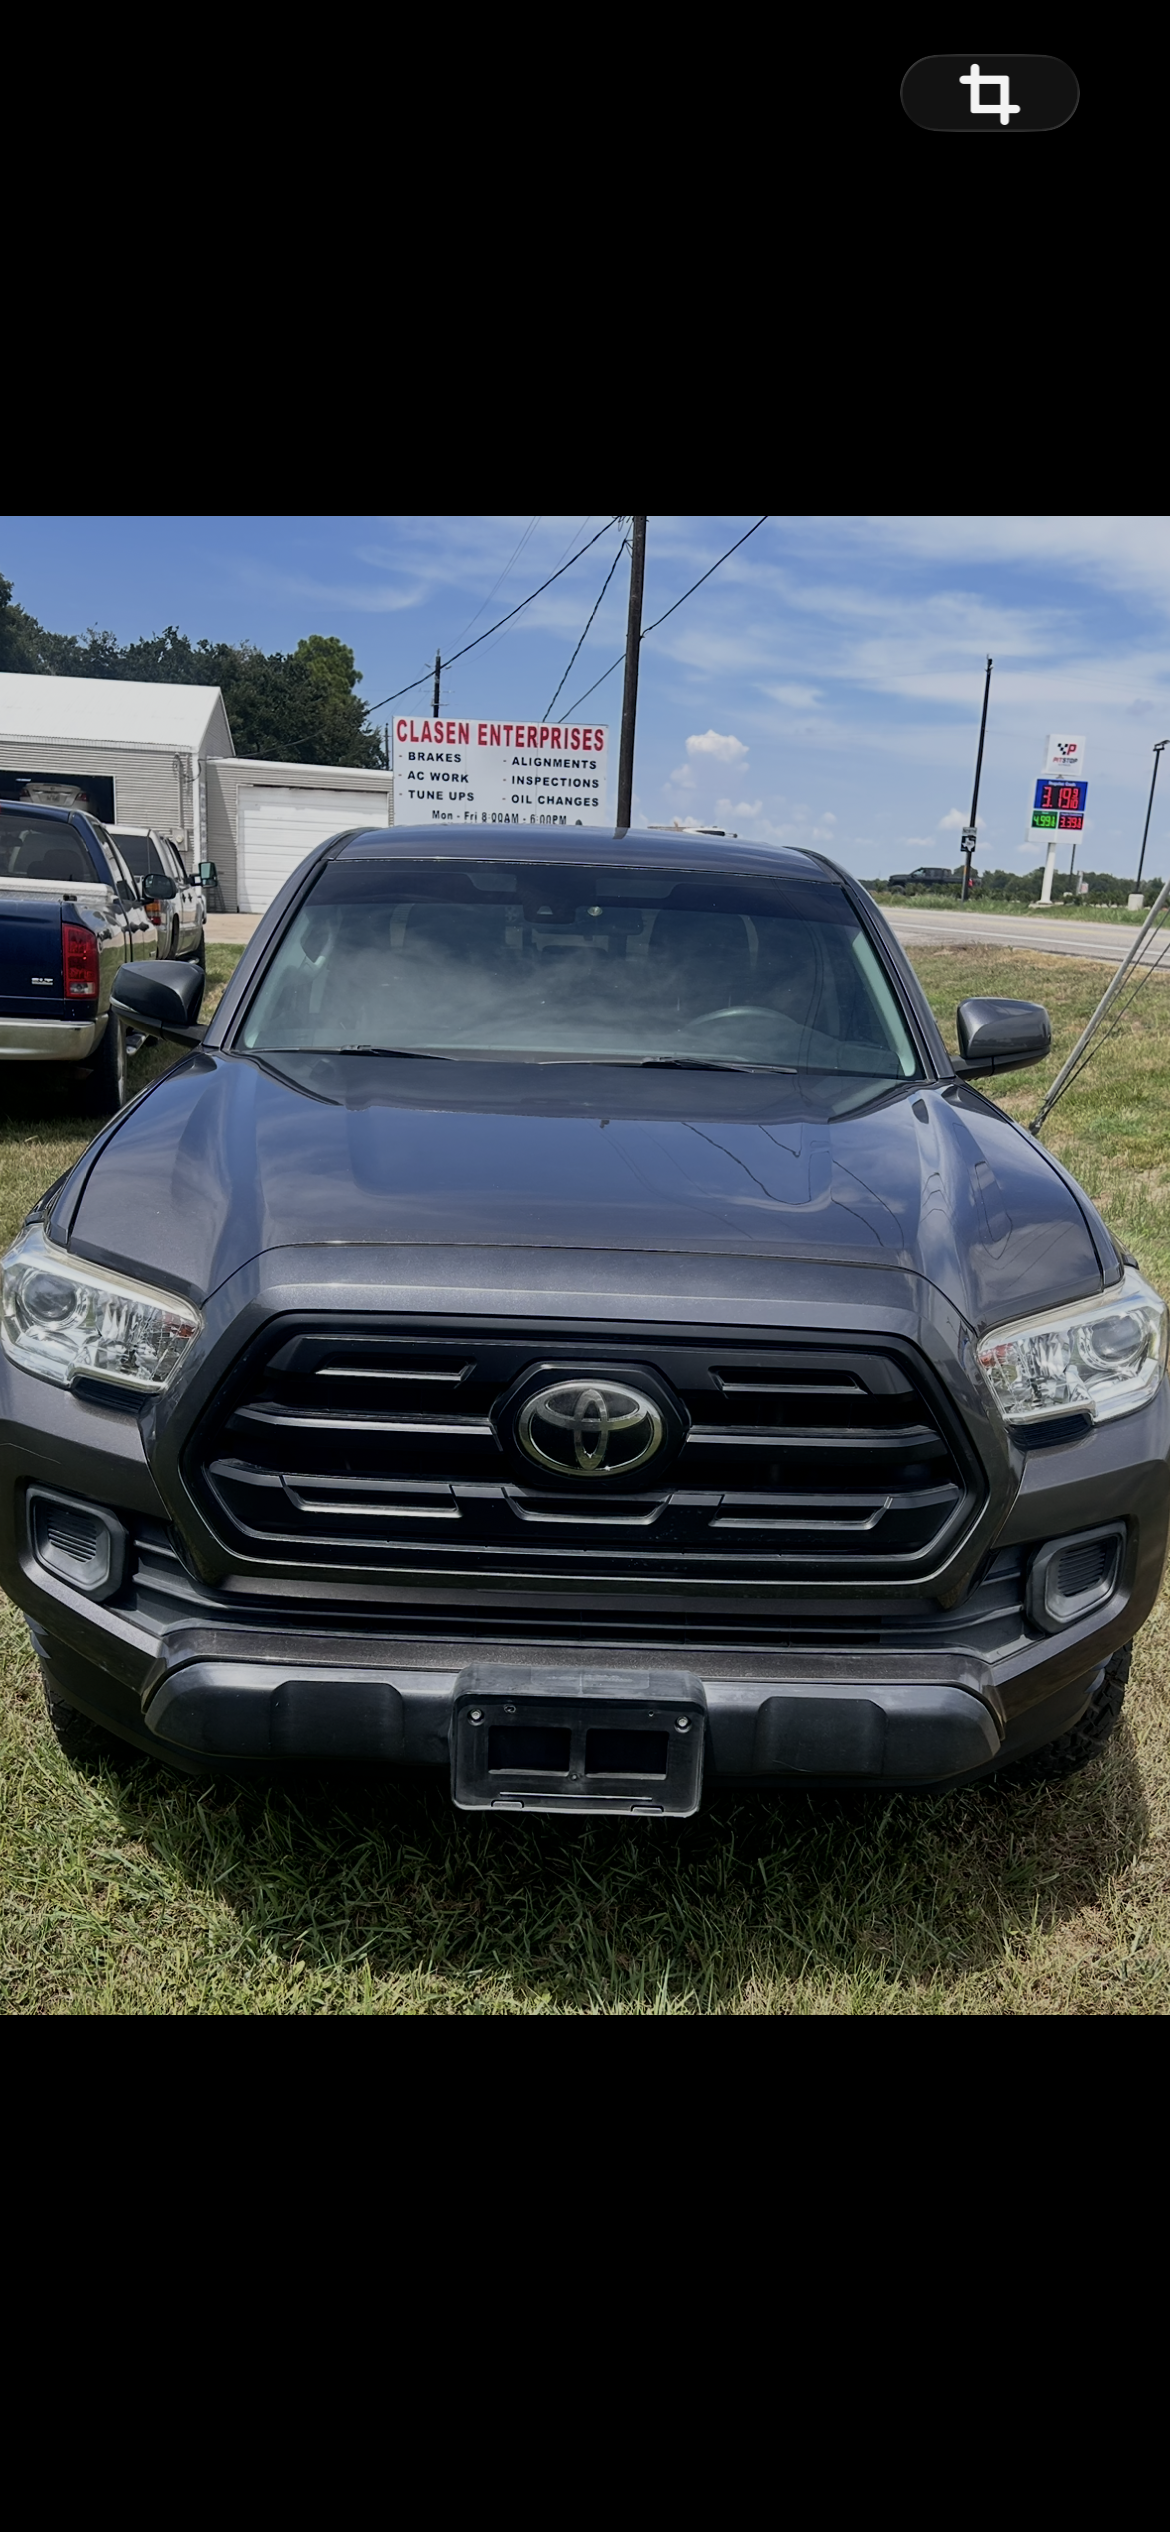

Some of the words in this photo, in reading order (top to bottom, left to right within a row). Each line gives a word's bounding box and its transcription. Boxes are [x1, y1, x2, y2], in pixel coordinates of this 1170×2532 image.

[396, 719, 470, 745] CLASEN
[477, 723, 604, 751] ENTERPRISES
[408, 751, 462, 763] BRAKES
[512, 756, 597, 770] ALIGNMENTS
[407, 770, 425, 781] AC
[430, 772, 469, 784] WORK
[511, 775, 599, 788] INSPECTIONS
[408, 790, 444, 800] TUNE
[449, 791, 475, 802] UPS
[511, 794, 532, 805] OIL
[537, 795, 599, 807] CHANGES
[432, 810, 453, 820] Mon
[464, 811, 478, 821] Fri
[481, 812, 519, 823] 8:00AM
[530, 814, 567, 825] 6:00PM
